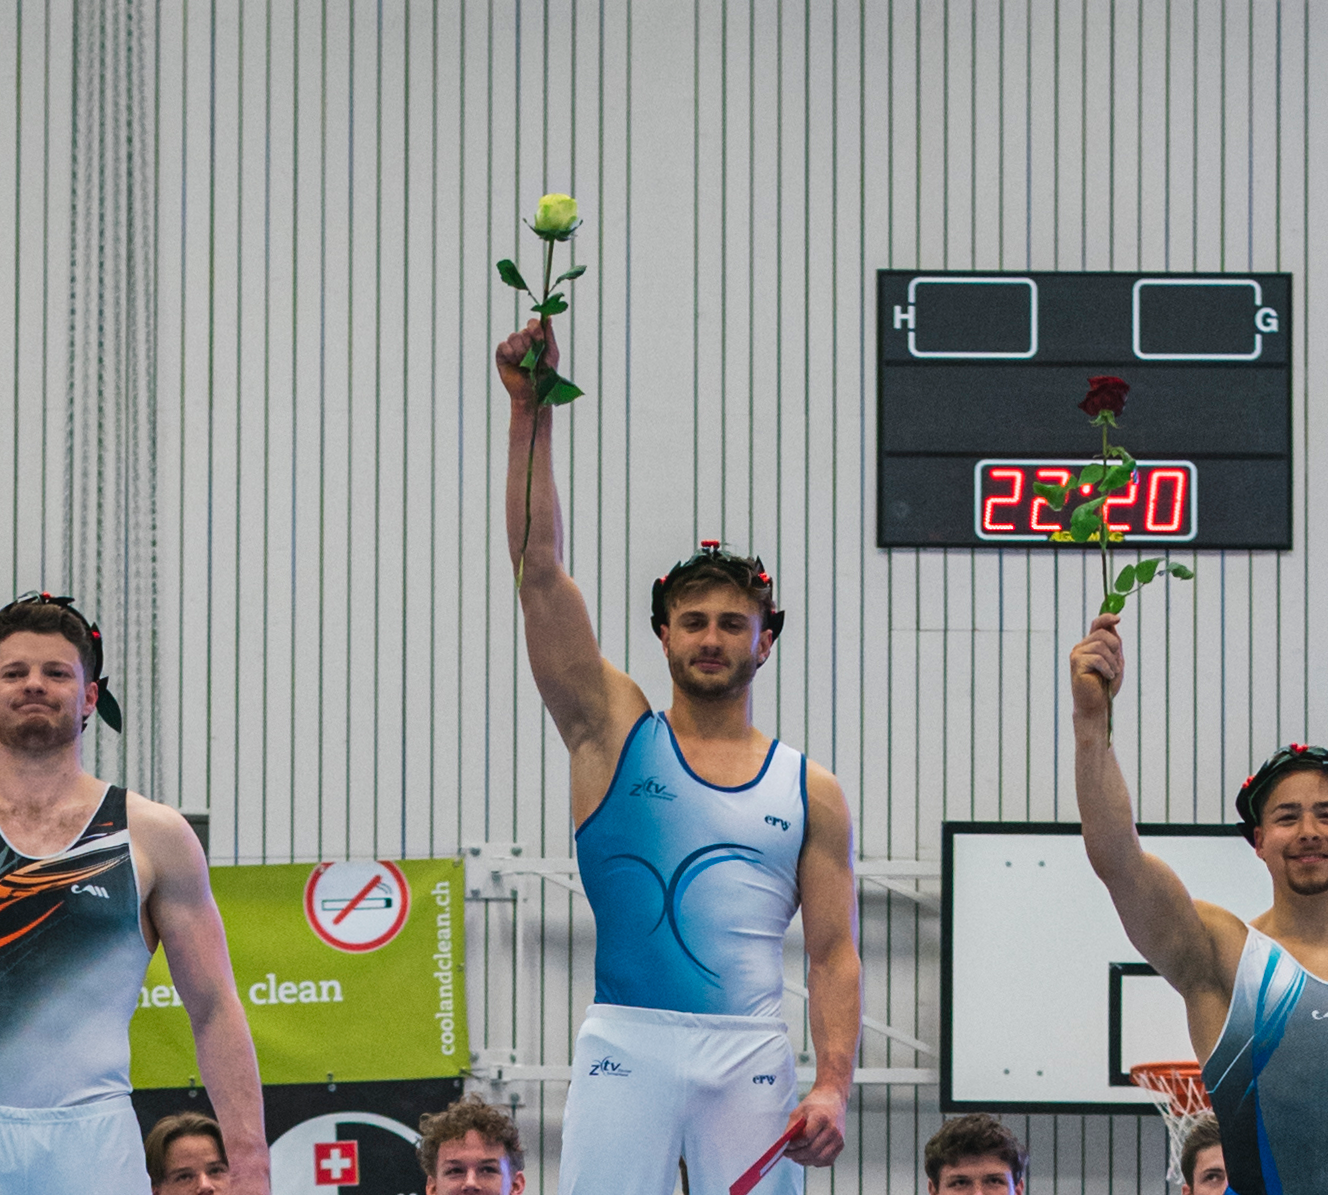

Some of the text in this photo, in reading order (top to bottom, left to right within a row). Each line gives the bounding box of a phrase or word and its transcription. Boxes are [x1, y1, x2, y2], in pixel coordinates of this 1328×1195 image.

[894, 305, 916, 330] H
[1255, 307, 1279, 333] G
[430, 880, 456, 1056] coolandclean.ch
[248, 973, 343, 1005] clean
